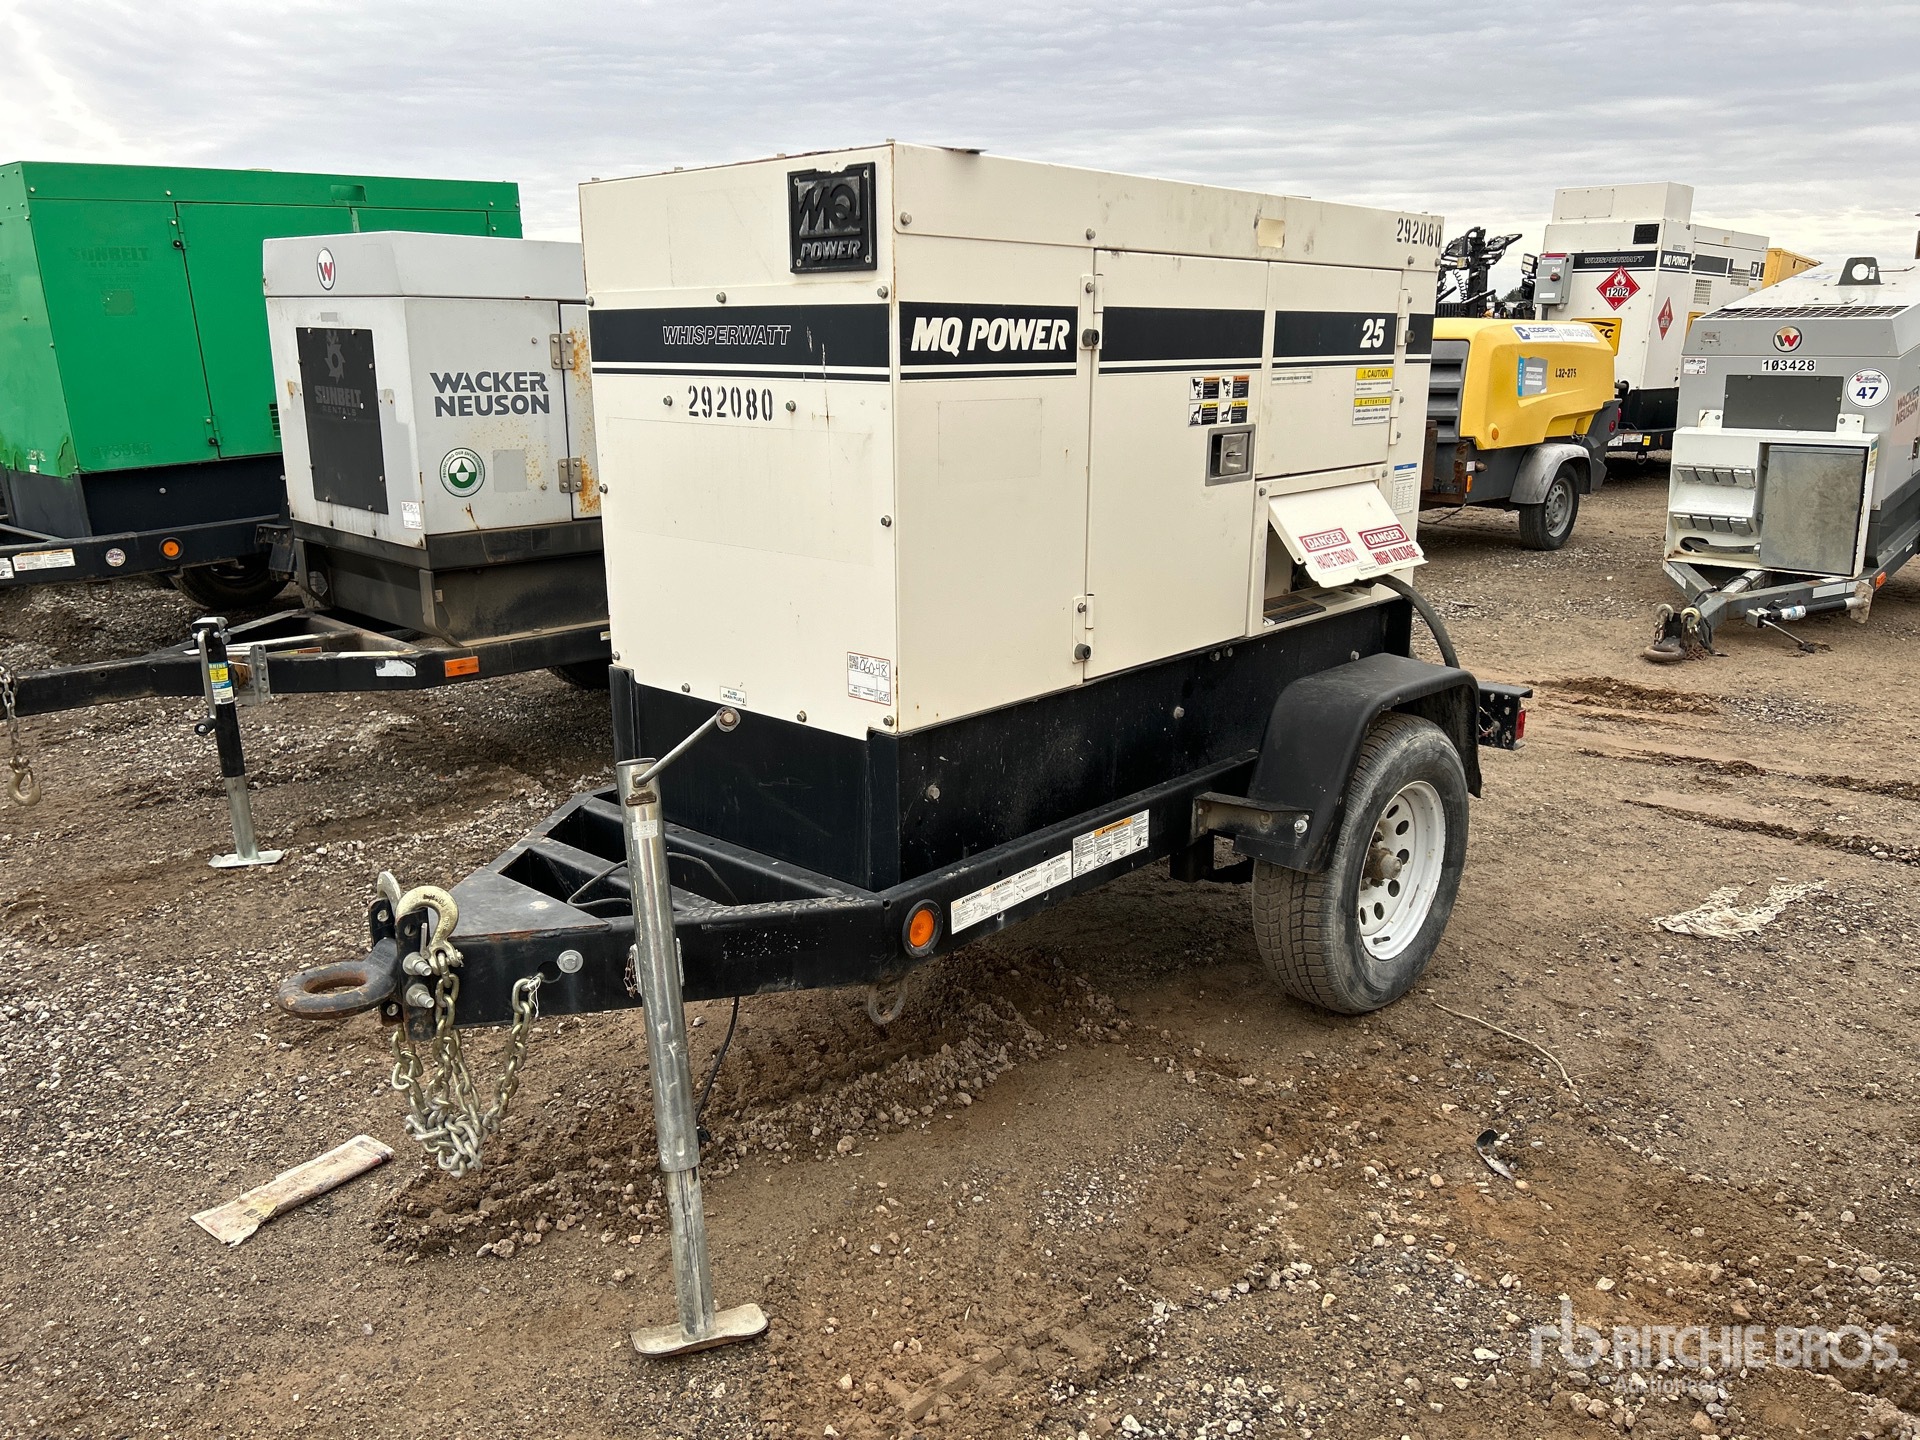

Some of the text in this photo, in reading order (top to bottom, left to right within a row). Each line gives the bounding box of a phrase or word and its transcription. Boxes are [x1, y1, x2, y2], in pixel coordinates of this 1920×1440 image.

[797, 179, 861, 236] MQ
[1396, 217, 1442, 248] 292080
[800, 240, 861, 261] POWER
[1671, 255, 1689, 267] POWER
[1607, 287, 1629, 297] 1202
[662, 325, 791, 345] WHISPERWATT
[910, 316, 1070, 357] MQ POWER
[1360, 318, 1386, 348] 25
[1367, 370, 1389, 378] CAUTION
[1555, 367, 1577, 378] L32-275
[1763, 360, 1815, 371] 103428
[429, 371, 549, 394] WACKER
[1856, 387, 1879, 399] 47
[314, 385, 361, 408] SUNBELT
[434, 394, 550, 417] NEUSON
[687, 385, 773, 421] 292080
[1304, 532, 1345, 549] DANGER
[1366, 529, 1402, 545] DANGER
[1371, 544, 1419, 566] HIGH VOLTAGE
